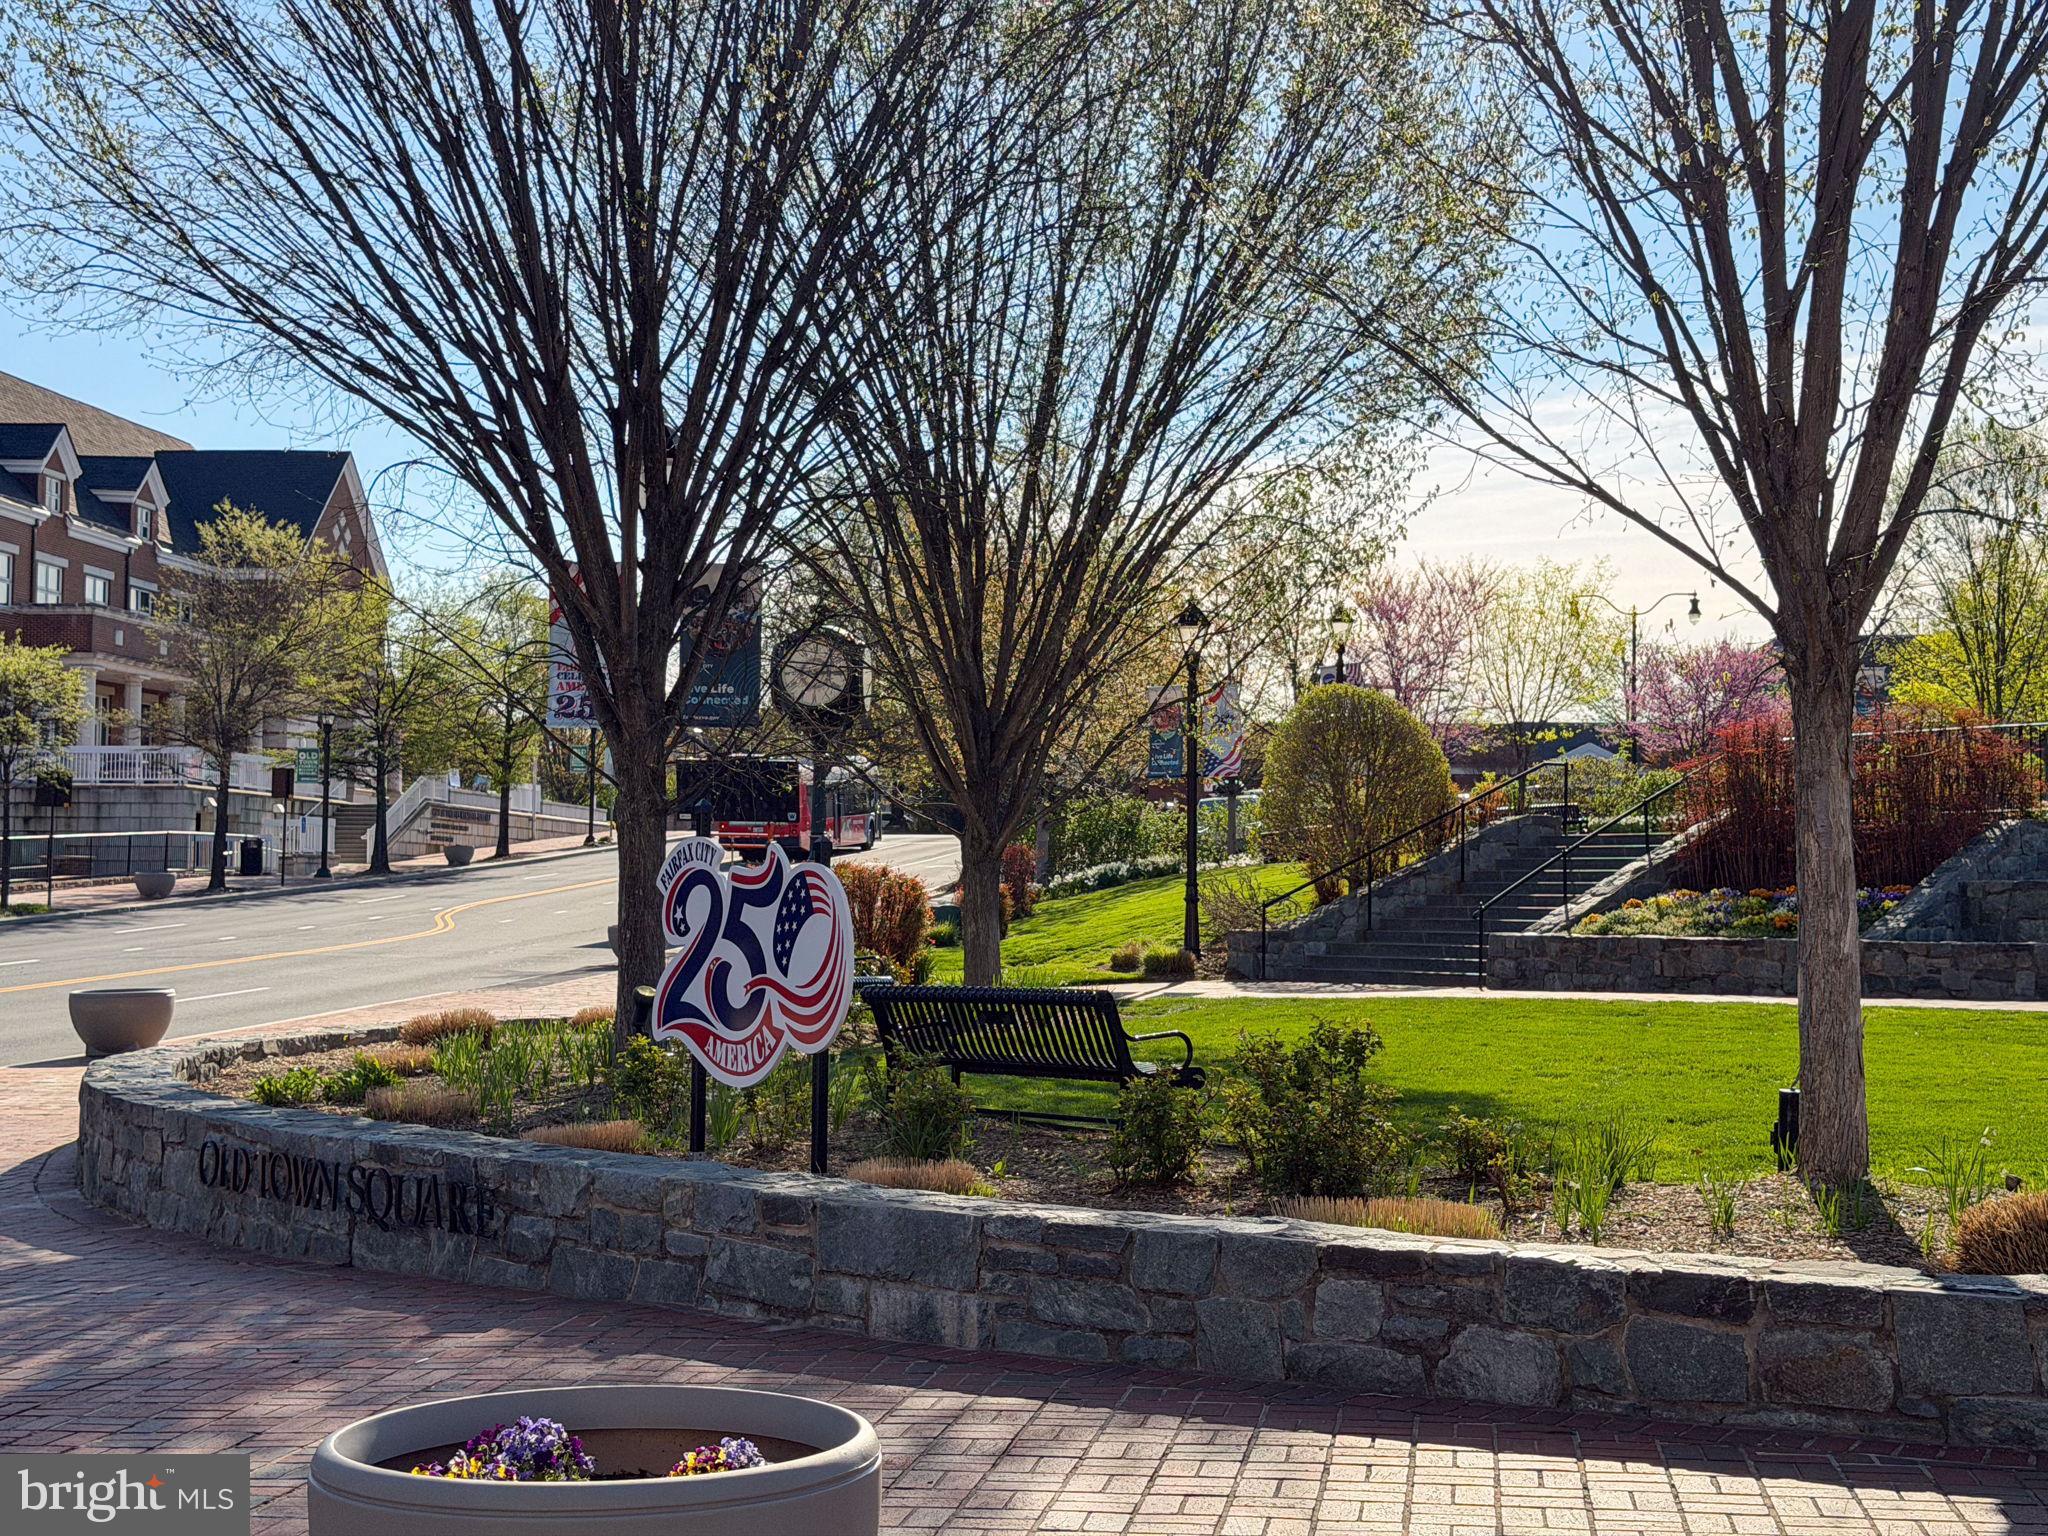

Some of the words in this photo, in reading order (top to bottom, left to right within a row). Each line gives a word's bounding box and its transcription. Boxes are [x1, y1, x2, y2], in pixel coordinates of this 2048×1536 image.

[710, 683, 735, 694] Life
[299, 752, 318, 760] OLD
[660, 843, 694, 891] FAIRFAX
[694, 840, 717, 868] CITY
[657, 850, 848, 1045] 250
[704, 1025, 776, 1072] AMERICA
[199, 1140, 250, 1195] OLD
[253, 1147, 339, 1212] TOWN
[345, 1165, 496, 1239] SQUARE
